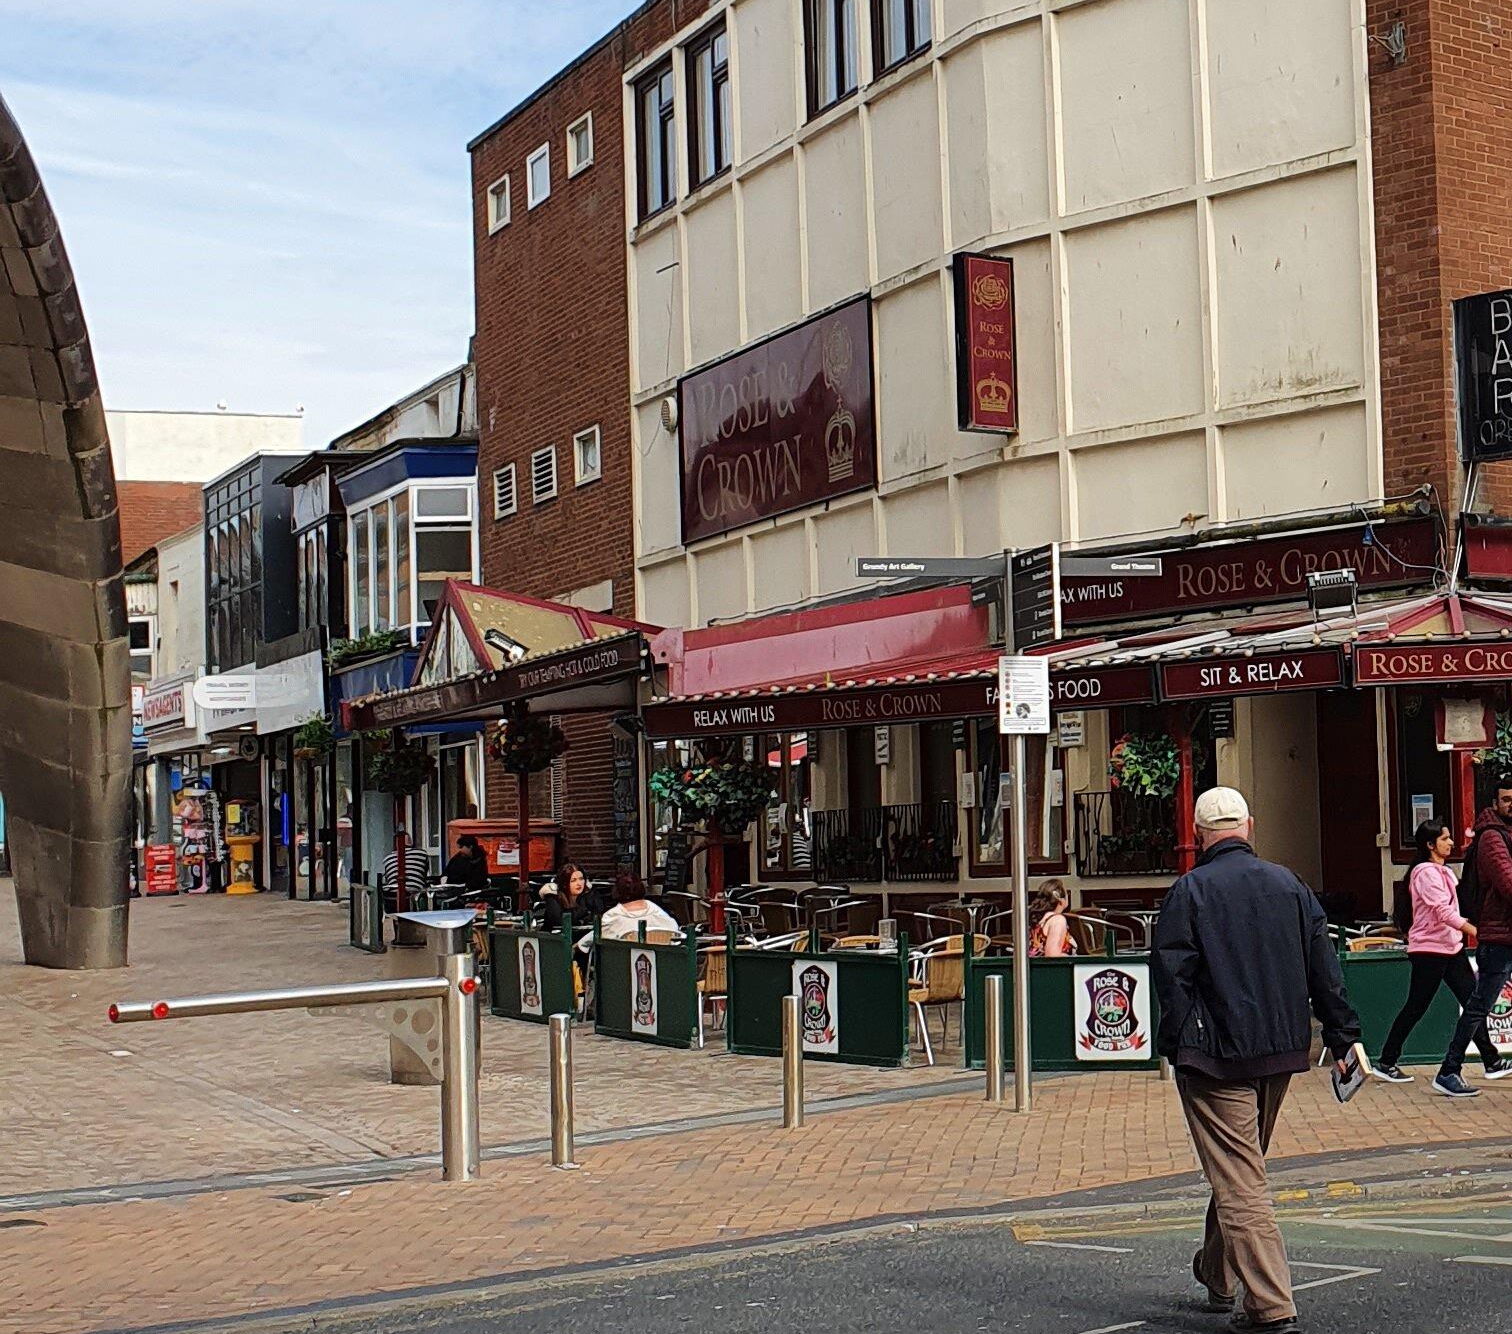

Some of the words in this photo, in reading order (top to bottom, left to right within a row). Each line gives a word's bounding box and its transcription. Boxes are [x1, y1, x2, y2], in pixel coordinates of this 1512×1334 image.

[979, 321, 1005, 334] ROSE
[973, 347, 1012, 361] CROWN
[699, 368, 769, 448] ROSE
[775, 362, 796, 419] &
[697, 434, 803, 521] CROWN
[1177, 563, 1245, 599] ROSE
[1254, 564, 1273, 588] &
[1280, 542, 1393, 586] CROWN
[1078, 584, 1106, 602] WITH
[1109, 582, 1124, 598] US
[1200, 666, 1222, 686] SIT
[1228, 665, 1242, 683] &
[1248, 660, 1304, 682] RELAX
[1370, 653, 1434, 675] ROSE
[1441, 653, 1459, 672] &
[1058, 678, 1100, 700] FOOD
[694, 709, 728, 727] RELAX
[730, 707, 759, 725] WITH
[761, 705, 775, 722] US
[822, 697, 861, 721] ROSE
[865, 701, 877, 717] &
[879, 693, 942, 717] CROWN
